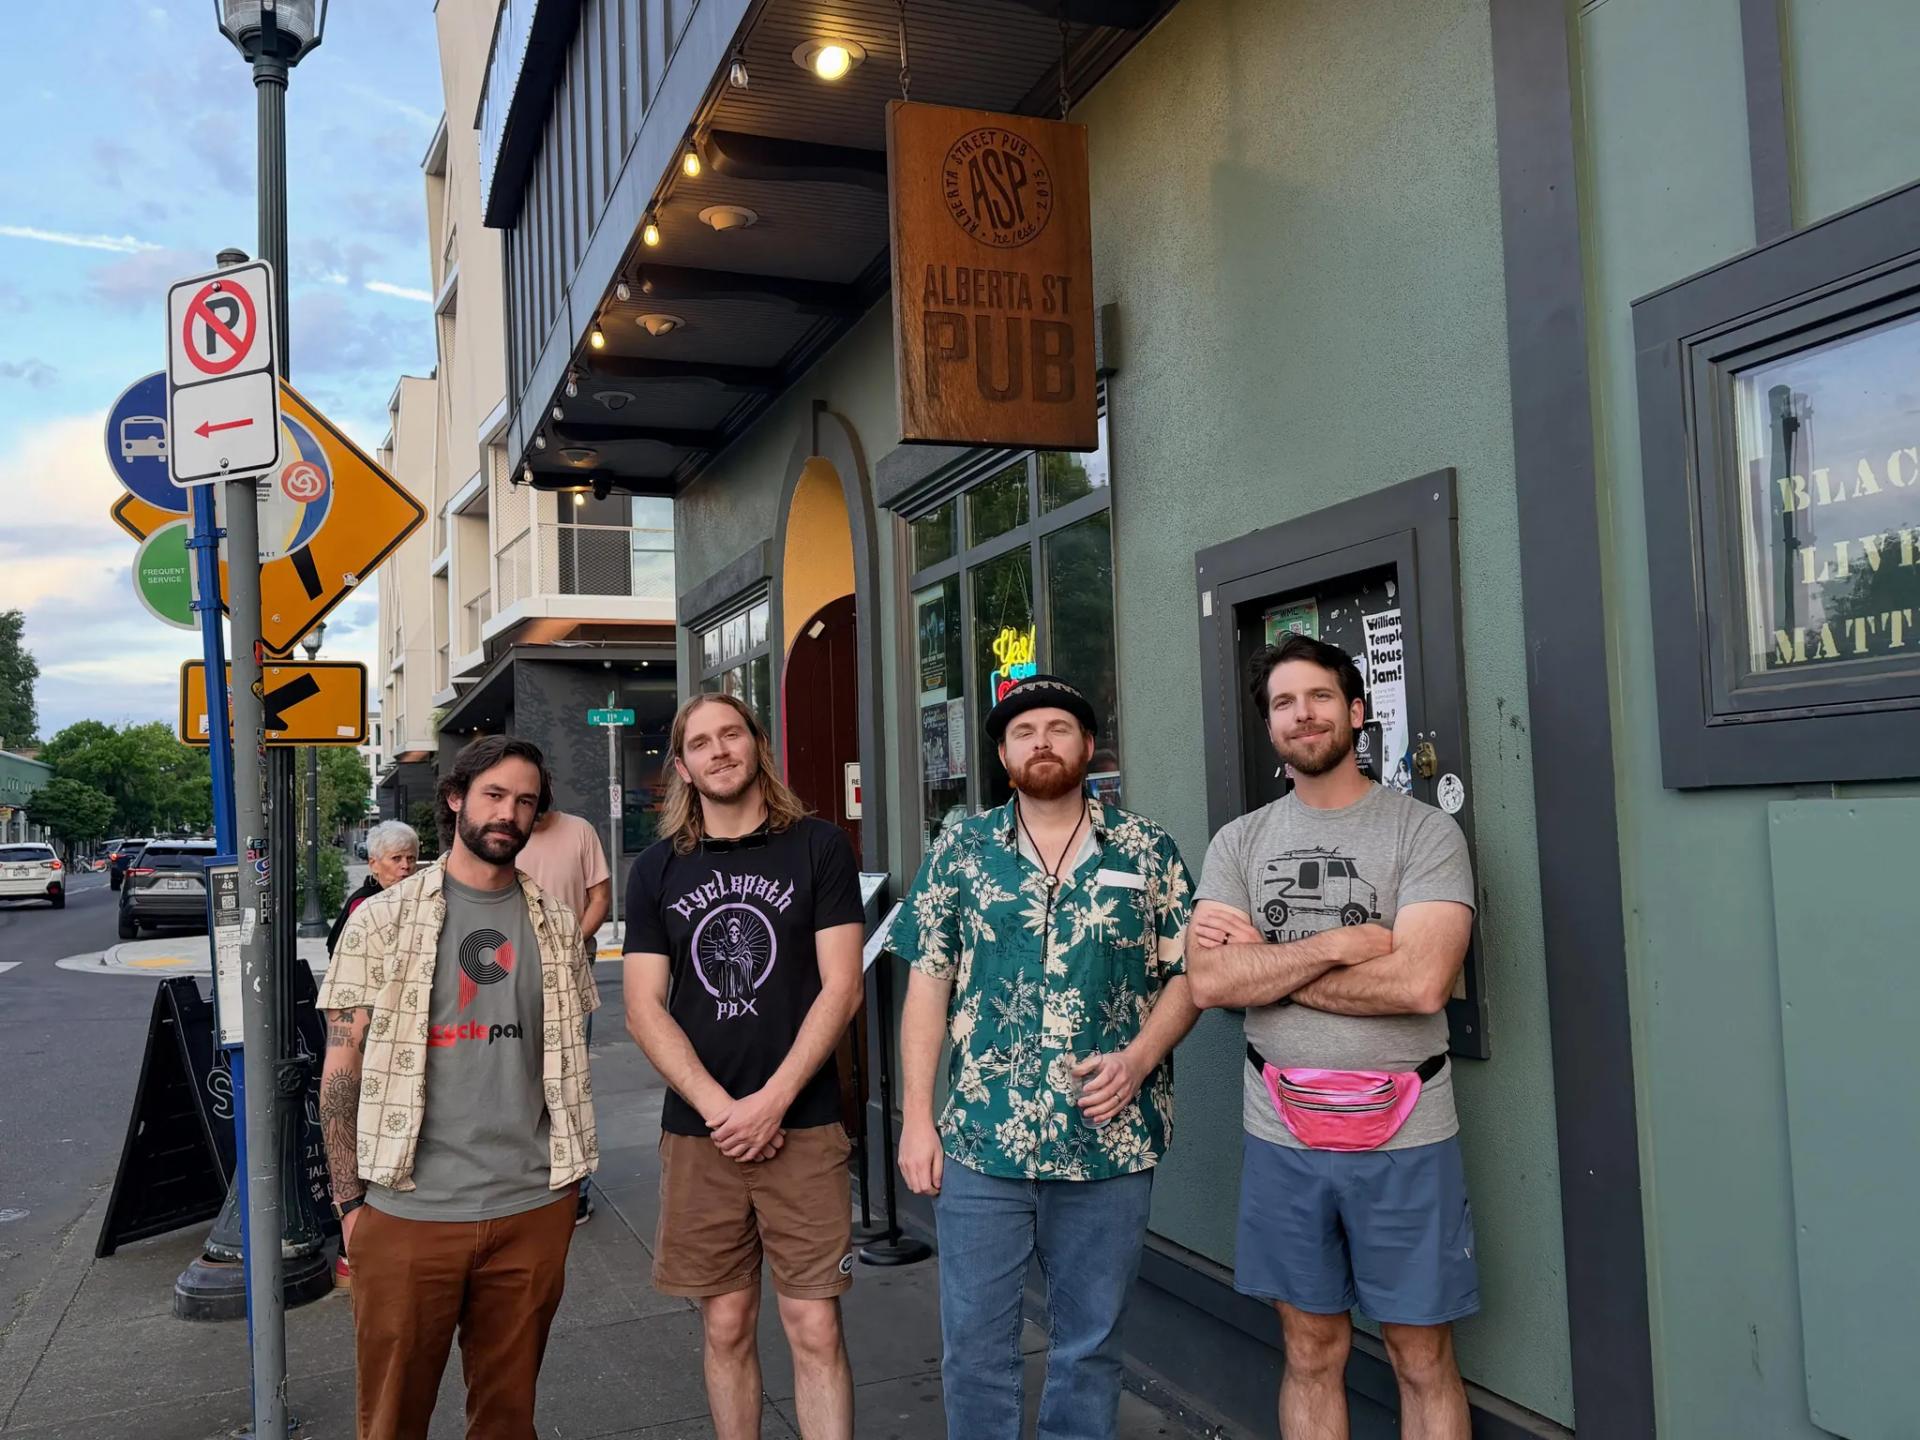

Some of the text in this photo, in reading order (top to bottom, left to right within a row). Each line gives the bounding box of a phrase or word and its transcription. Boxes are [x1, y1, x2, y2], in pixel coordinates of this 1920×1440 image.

[946, 131, 1028, 234] ALBERTA STREET PUB
[968, 148, 1028, 230] ASP
[922, 263, 1073, 316] ALBERTA ST
[923, 310, 1077, 404] PUB
[143, 567, 185, 576] FREQUENT
[148, 576, 182, 585] SERVICE
[1372, 664, 1402, 685] Jam!
[1376, 710, 1390, 719] May
[221, 881, 234, 890] 48
